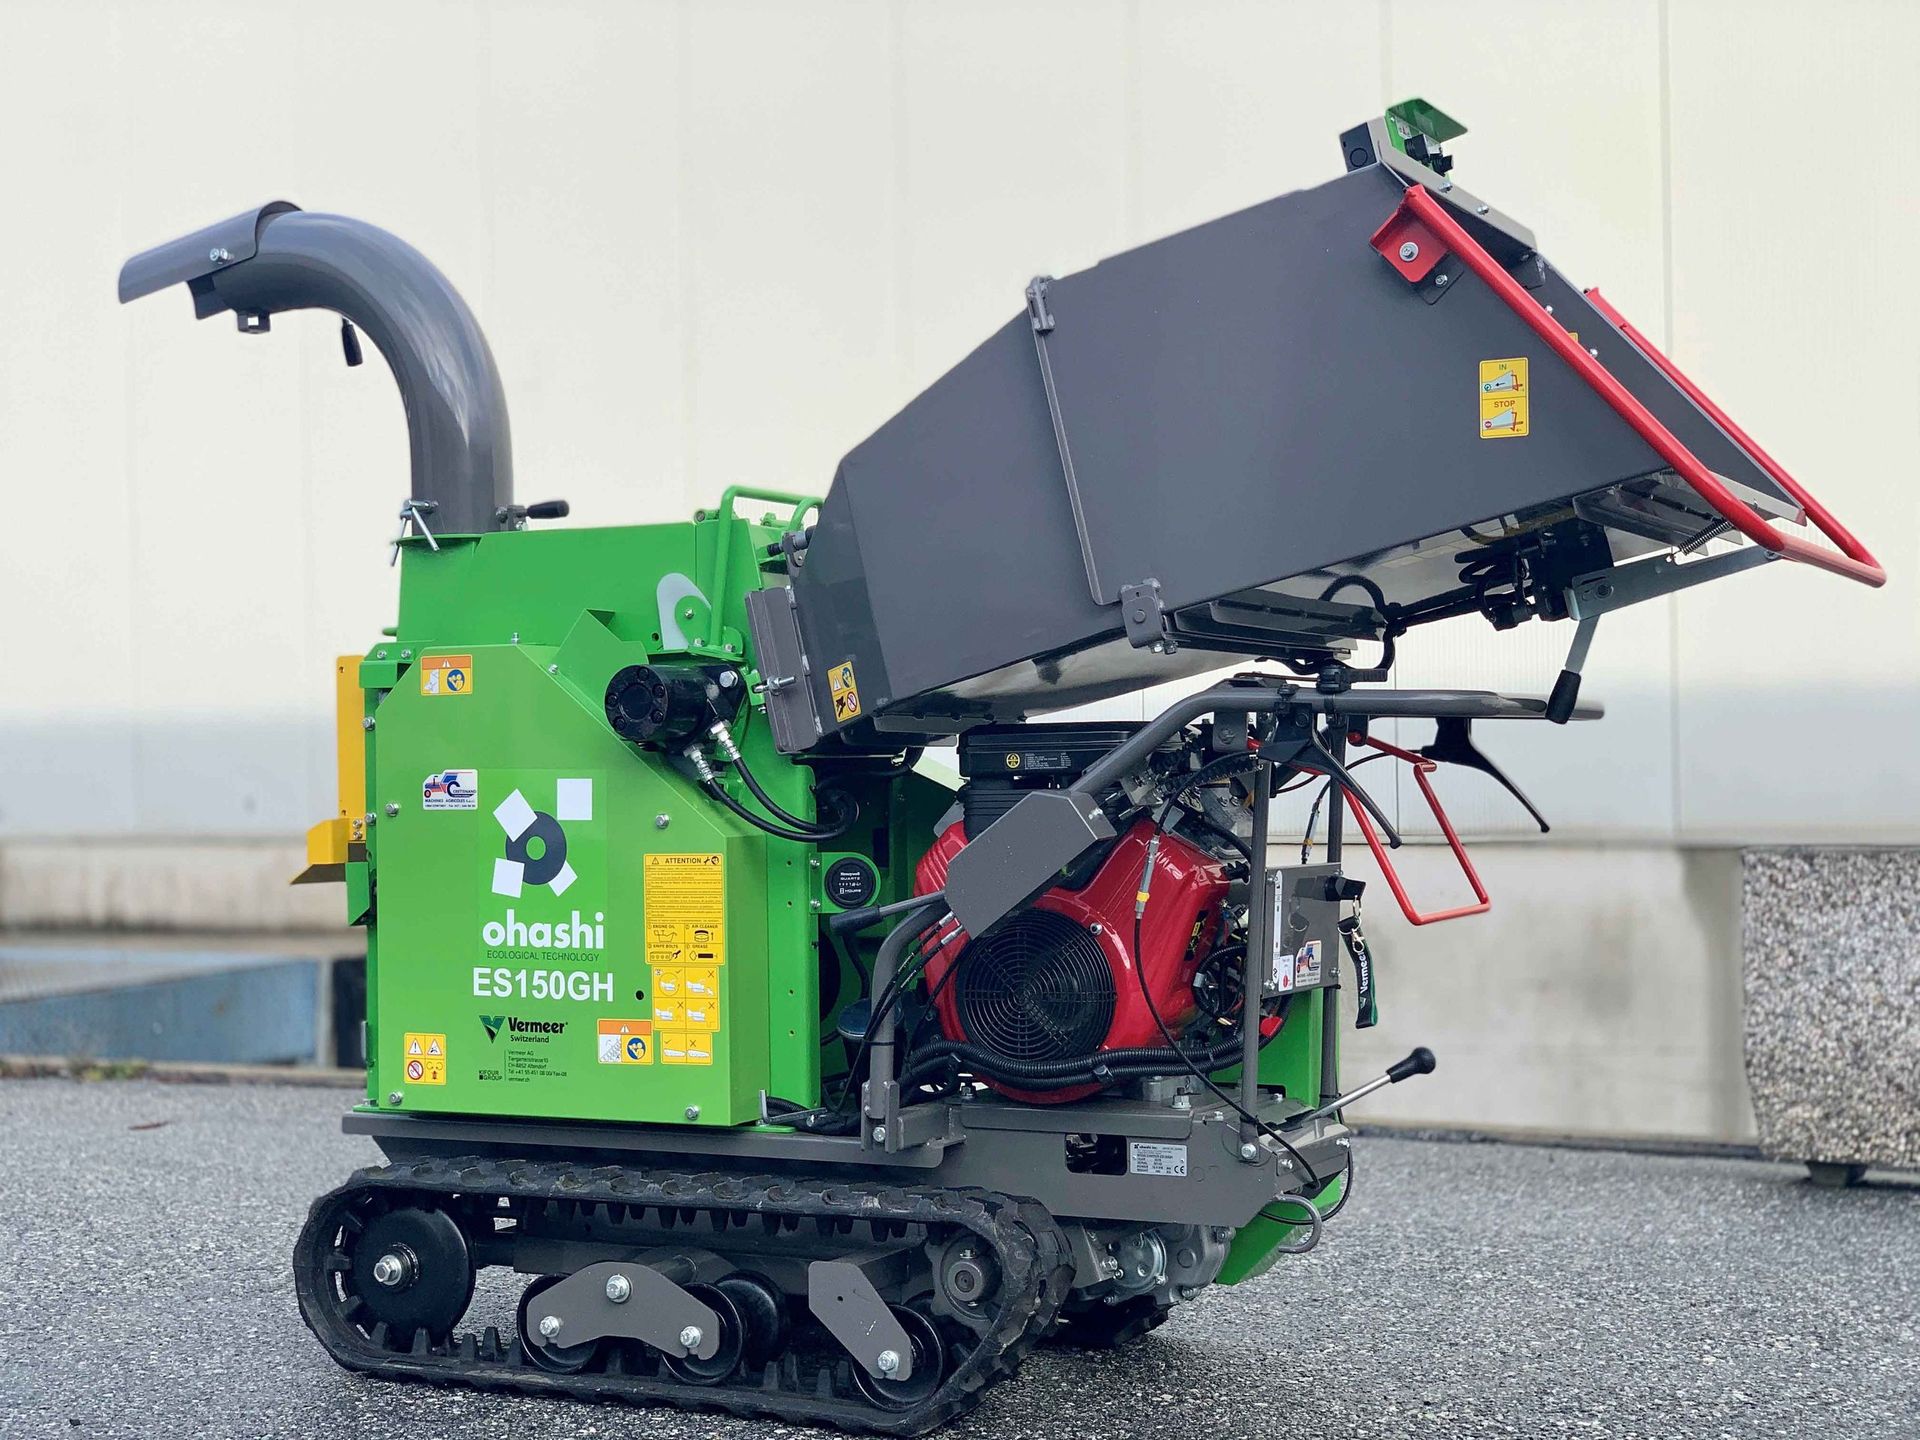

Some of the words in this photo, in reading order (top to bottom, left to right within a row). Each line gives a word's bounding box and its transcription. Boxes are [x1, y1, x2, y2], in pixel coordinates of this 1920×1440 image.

[1494, 400, 1515, 408] STOP
[482, 909, 604, 949] ohashi
[487, 950, 539, 960] ECOLOGICAL
[541, 952, 600, 962] TECHNOLOGY
[473, 967, 614, 1002] ES150GH
[508, 1017, 565, 1034] Vermeer
[510, 1035, 550, 1043] Switzerland
